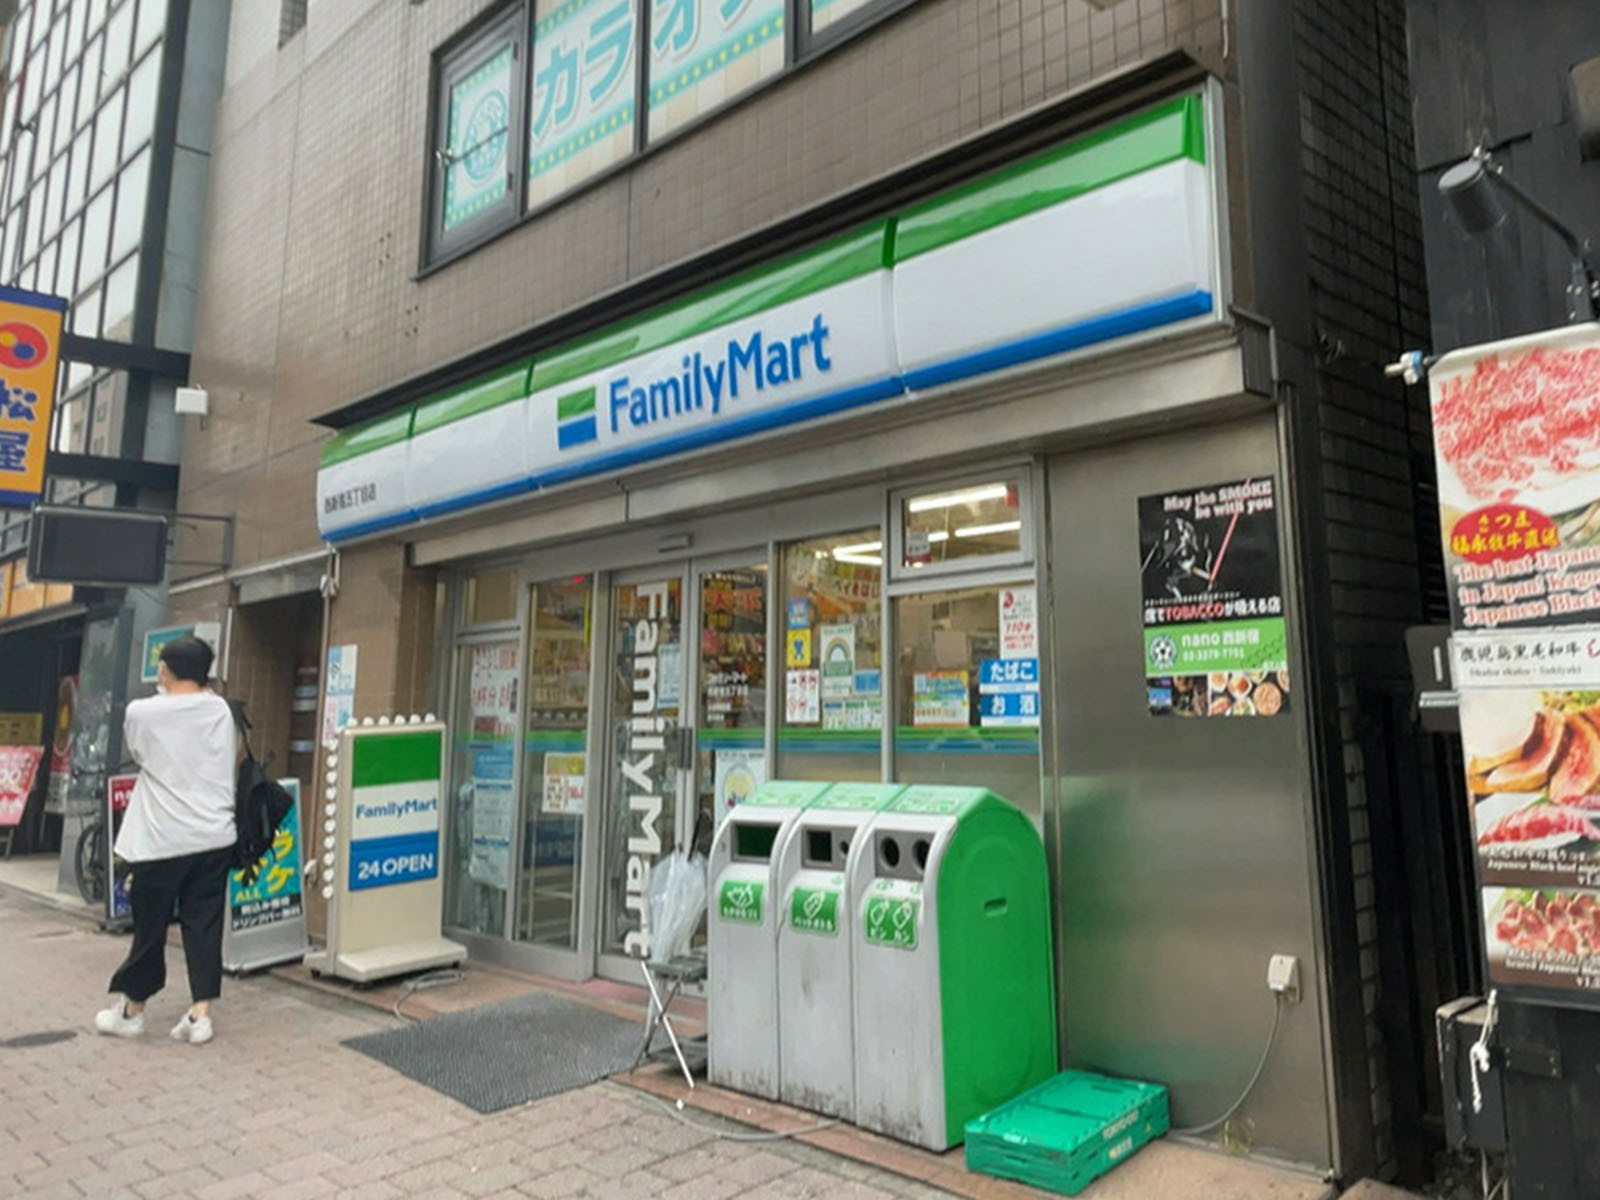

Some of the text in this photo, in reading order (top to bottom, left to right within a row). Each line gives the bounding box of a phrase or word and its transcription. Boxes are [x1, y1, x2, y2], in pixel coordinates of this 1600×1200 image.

[608, 313, 831, 433] FamilyMart
[1247, 497, 1273, 515] you
[990, 660, 1034, 683] たばこ
[621, 581, 668, 958] FamilyMart
[356, 797, 437, 819] FamilyMart
[358, 853, 434, 880] 24 OPEN
